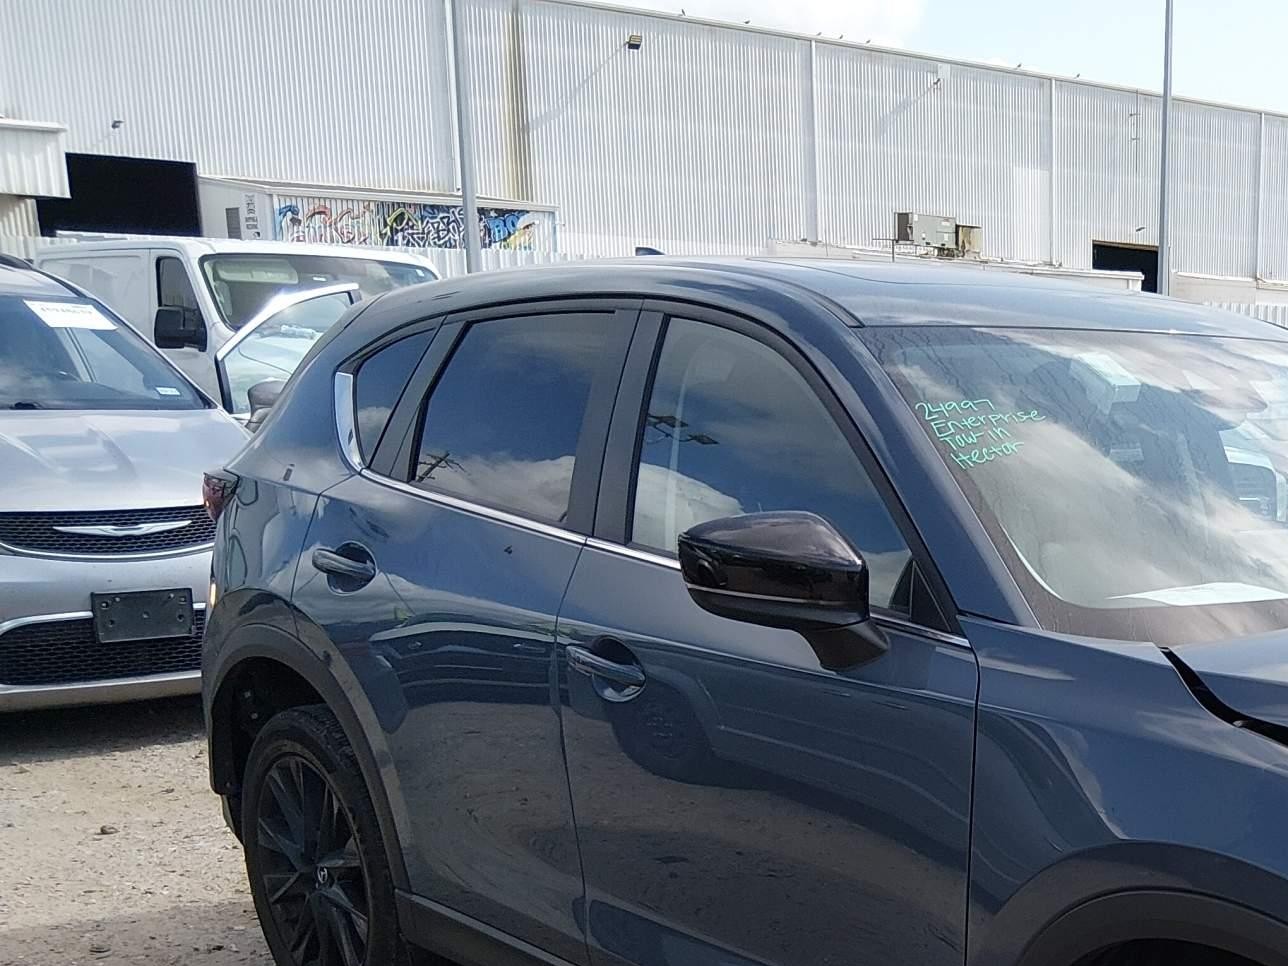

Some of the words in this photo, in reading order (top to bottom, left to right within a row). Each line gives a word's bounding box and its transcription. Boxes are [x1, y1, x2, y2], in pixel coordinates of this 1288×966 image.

[915, 399, 996, 420] 24997
[930, 410, 1046, 437] Enterprise
[950, 442, 1025, 469] Hector
